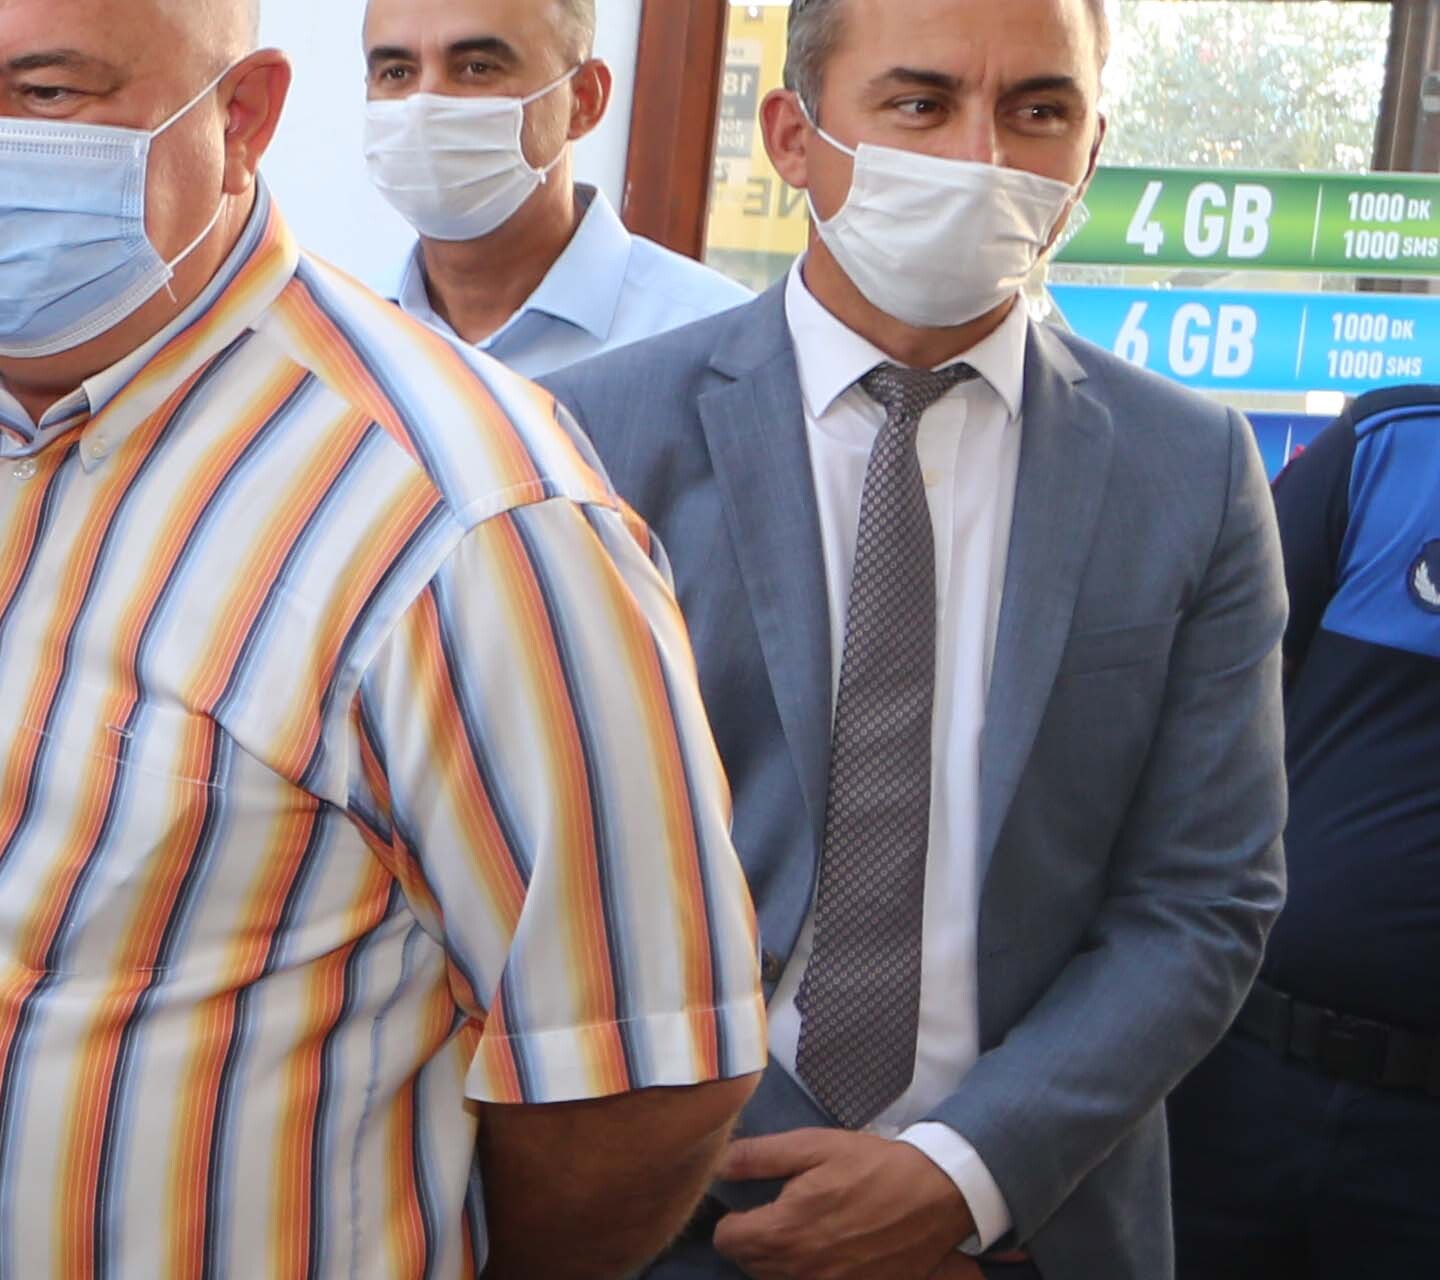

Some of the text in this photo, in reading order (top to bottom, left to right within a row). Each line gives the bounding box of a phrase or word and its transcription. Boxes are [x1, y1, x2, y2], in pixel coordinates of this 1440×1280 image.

[1126, 181, 1273, 258] 4 GB
[1348, 192, 1431, 222] 1000 DK
[1343, 230, 1439, 259] 1000 SMS
[1113, 301, 1257, 378] 6 GB
[1331, 312, 1414, 342] 1000 DK
[1327, 349, 1423, 379] 1000 SMS
